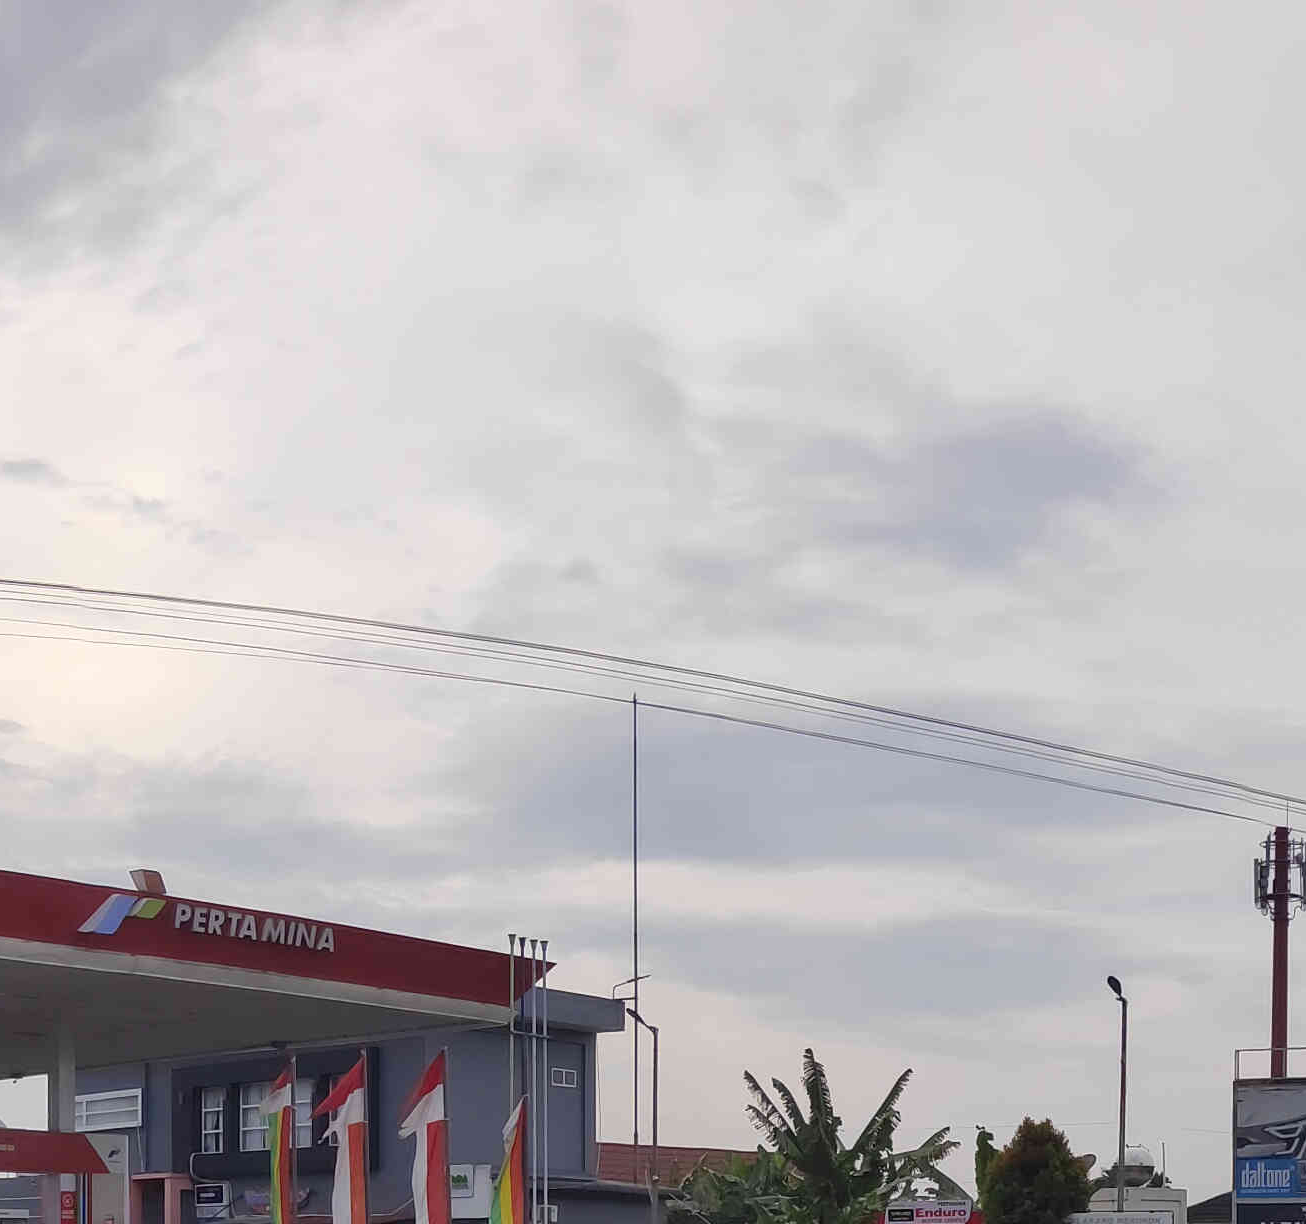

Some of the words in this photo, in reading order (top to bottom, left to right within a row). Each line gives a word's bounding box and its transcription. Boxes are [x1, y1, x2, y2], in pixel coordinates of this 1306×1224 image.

[174, 902, 335, 952] PERTAMINA
[1241, 1162, 1290, 1188] daltone
[915, 1207, 966, 1217] Enduro
